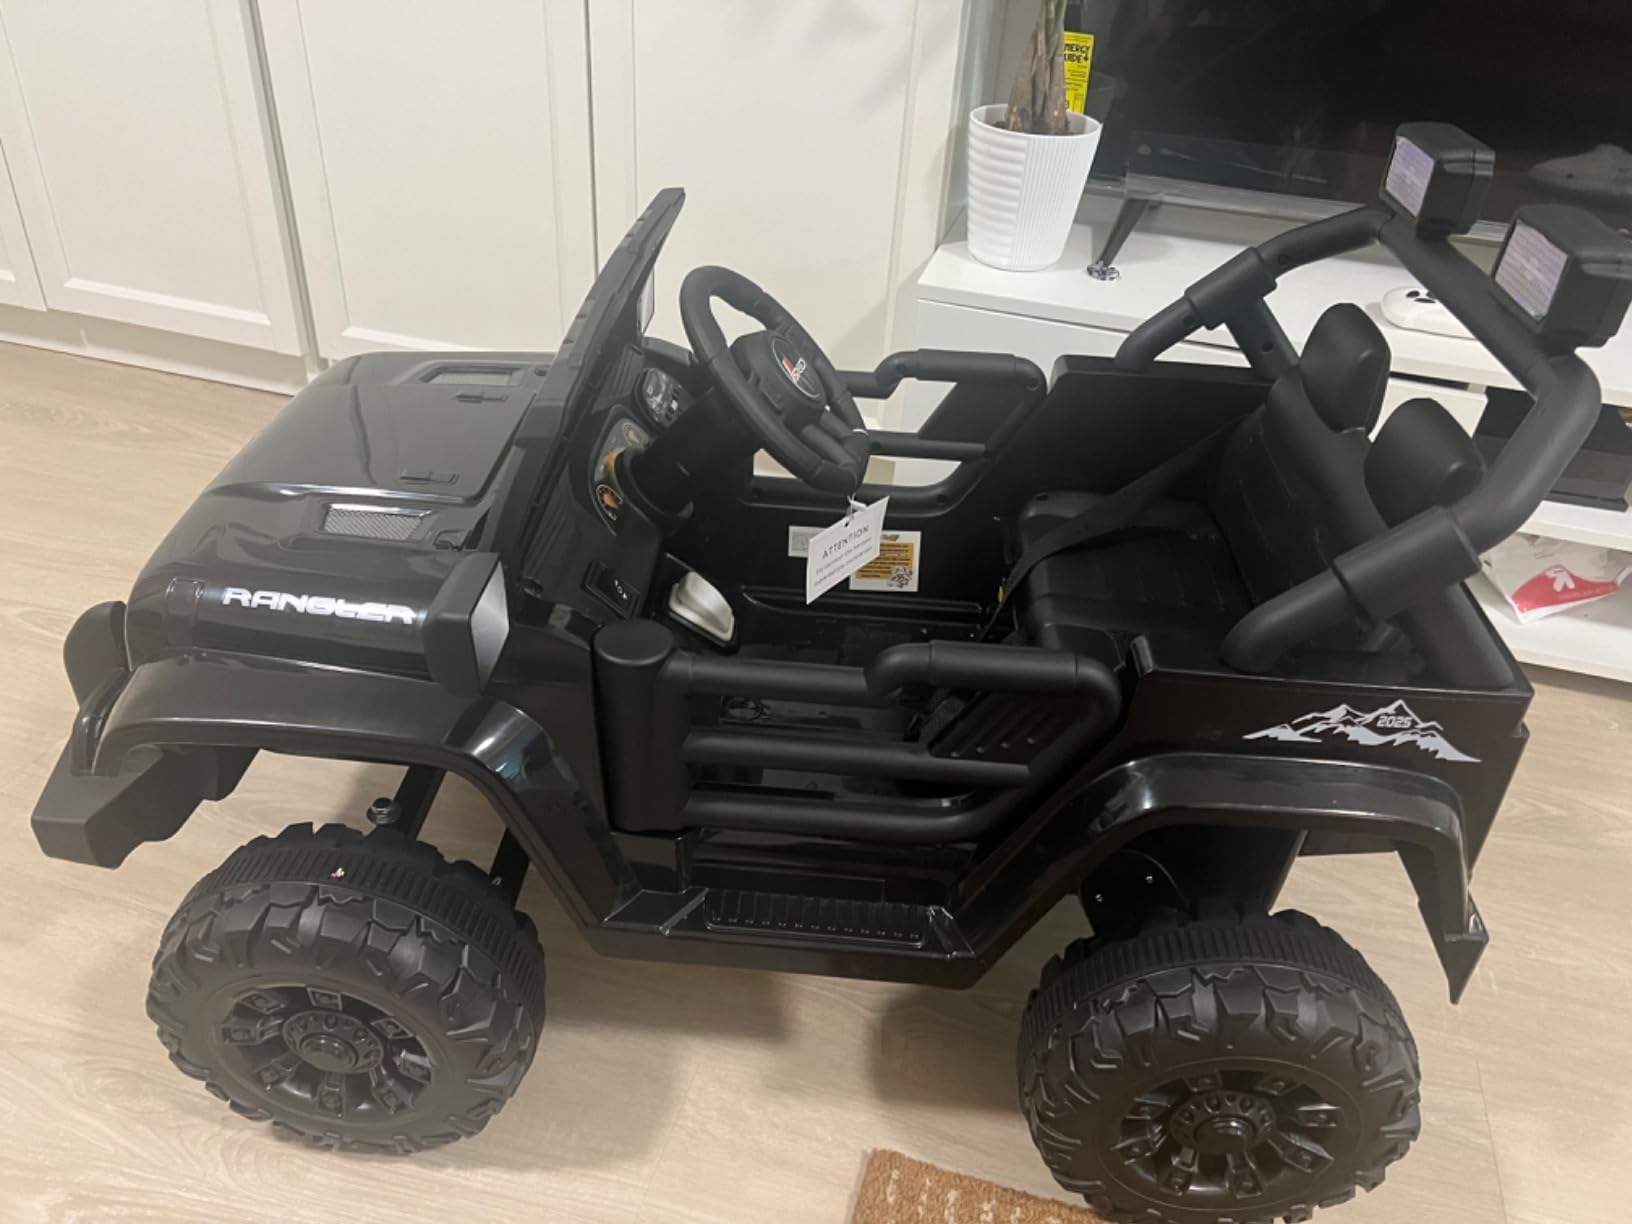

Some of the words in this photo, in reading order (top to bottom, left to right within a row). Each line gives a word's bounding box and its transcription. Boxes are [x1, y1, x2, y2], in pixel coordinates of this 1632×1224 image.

[1064, 44, 1090, 56] NERGY
[1064, 53, 1083, 63] UIDE
[822, 525, 869, 560] ATTENTION
[1377, 715, 1412, 728] 2025
